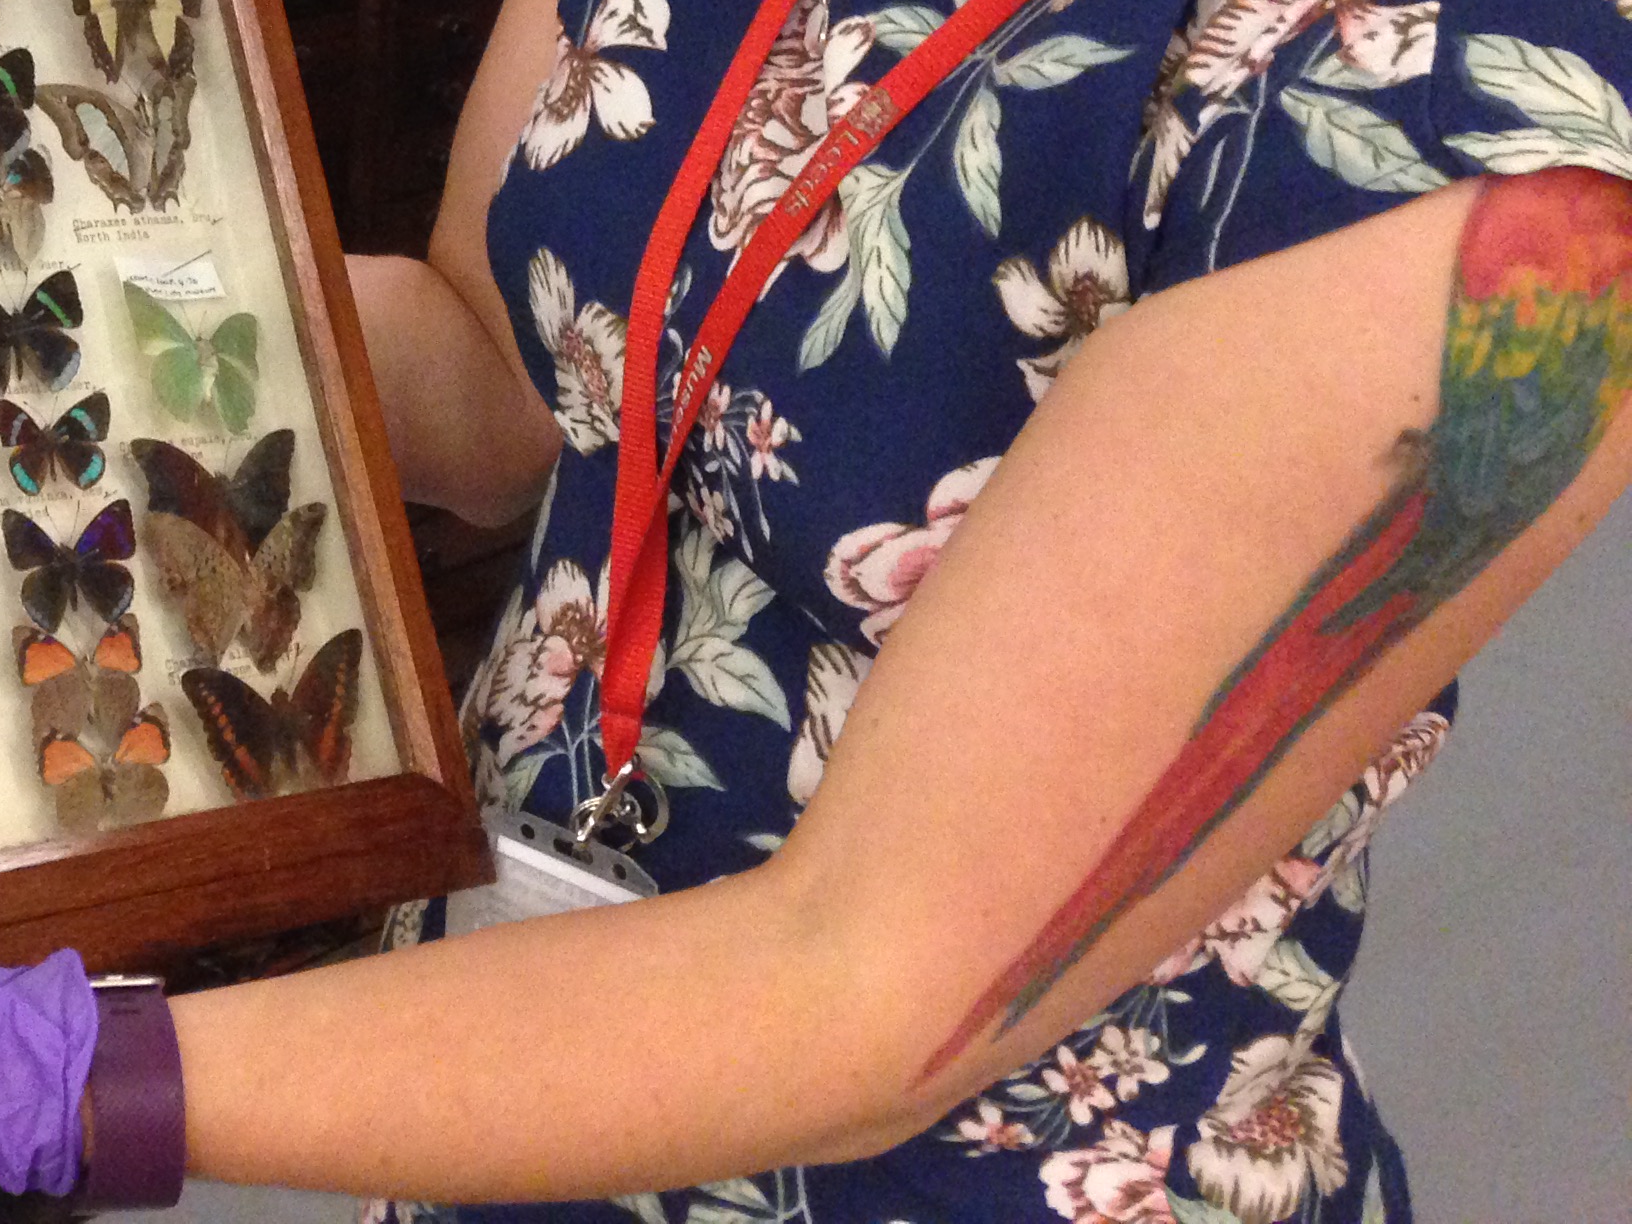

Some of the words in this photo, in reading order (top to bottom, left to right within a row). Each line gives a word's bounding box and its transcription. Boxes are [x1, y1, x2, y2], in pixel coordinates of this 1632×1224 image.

[784, 129, 860, 218] Leeds
[75, 231, 111, 244] North
[116, 229, 151, 242] India
